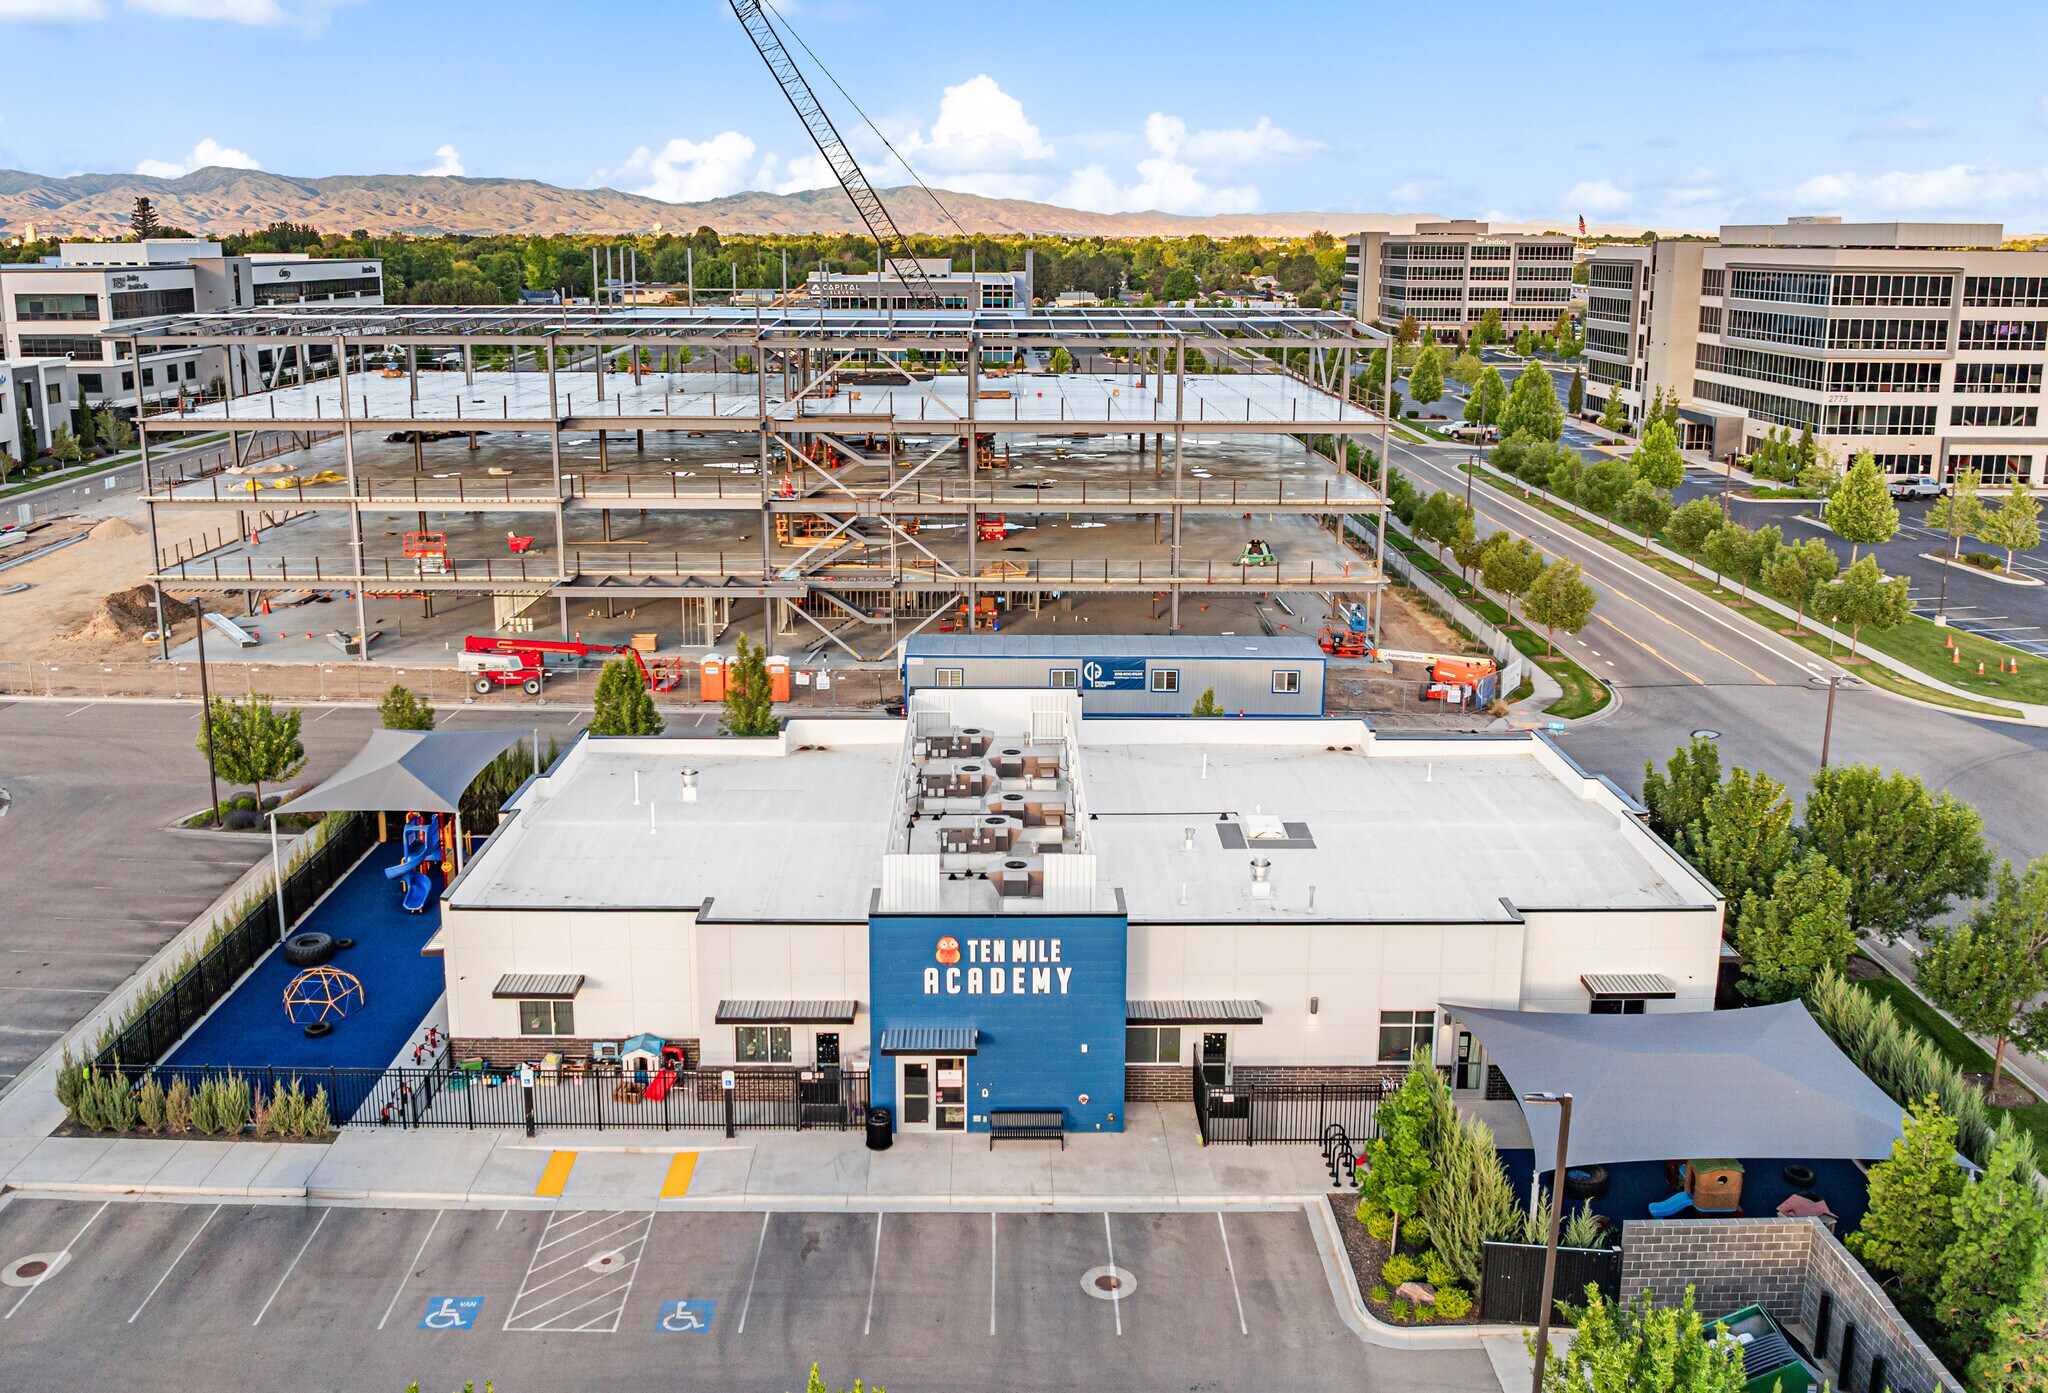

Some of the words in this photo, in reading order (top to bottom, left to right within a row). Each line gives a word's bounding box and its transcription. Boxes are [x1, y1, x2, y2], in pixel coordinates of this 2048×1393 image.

[967, 939, 1005, 963] TEN
[1012, 939, 1061, 963] MILE
[924, 966, 1072, 994] ACADEMY
